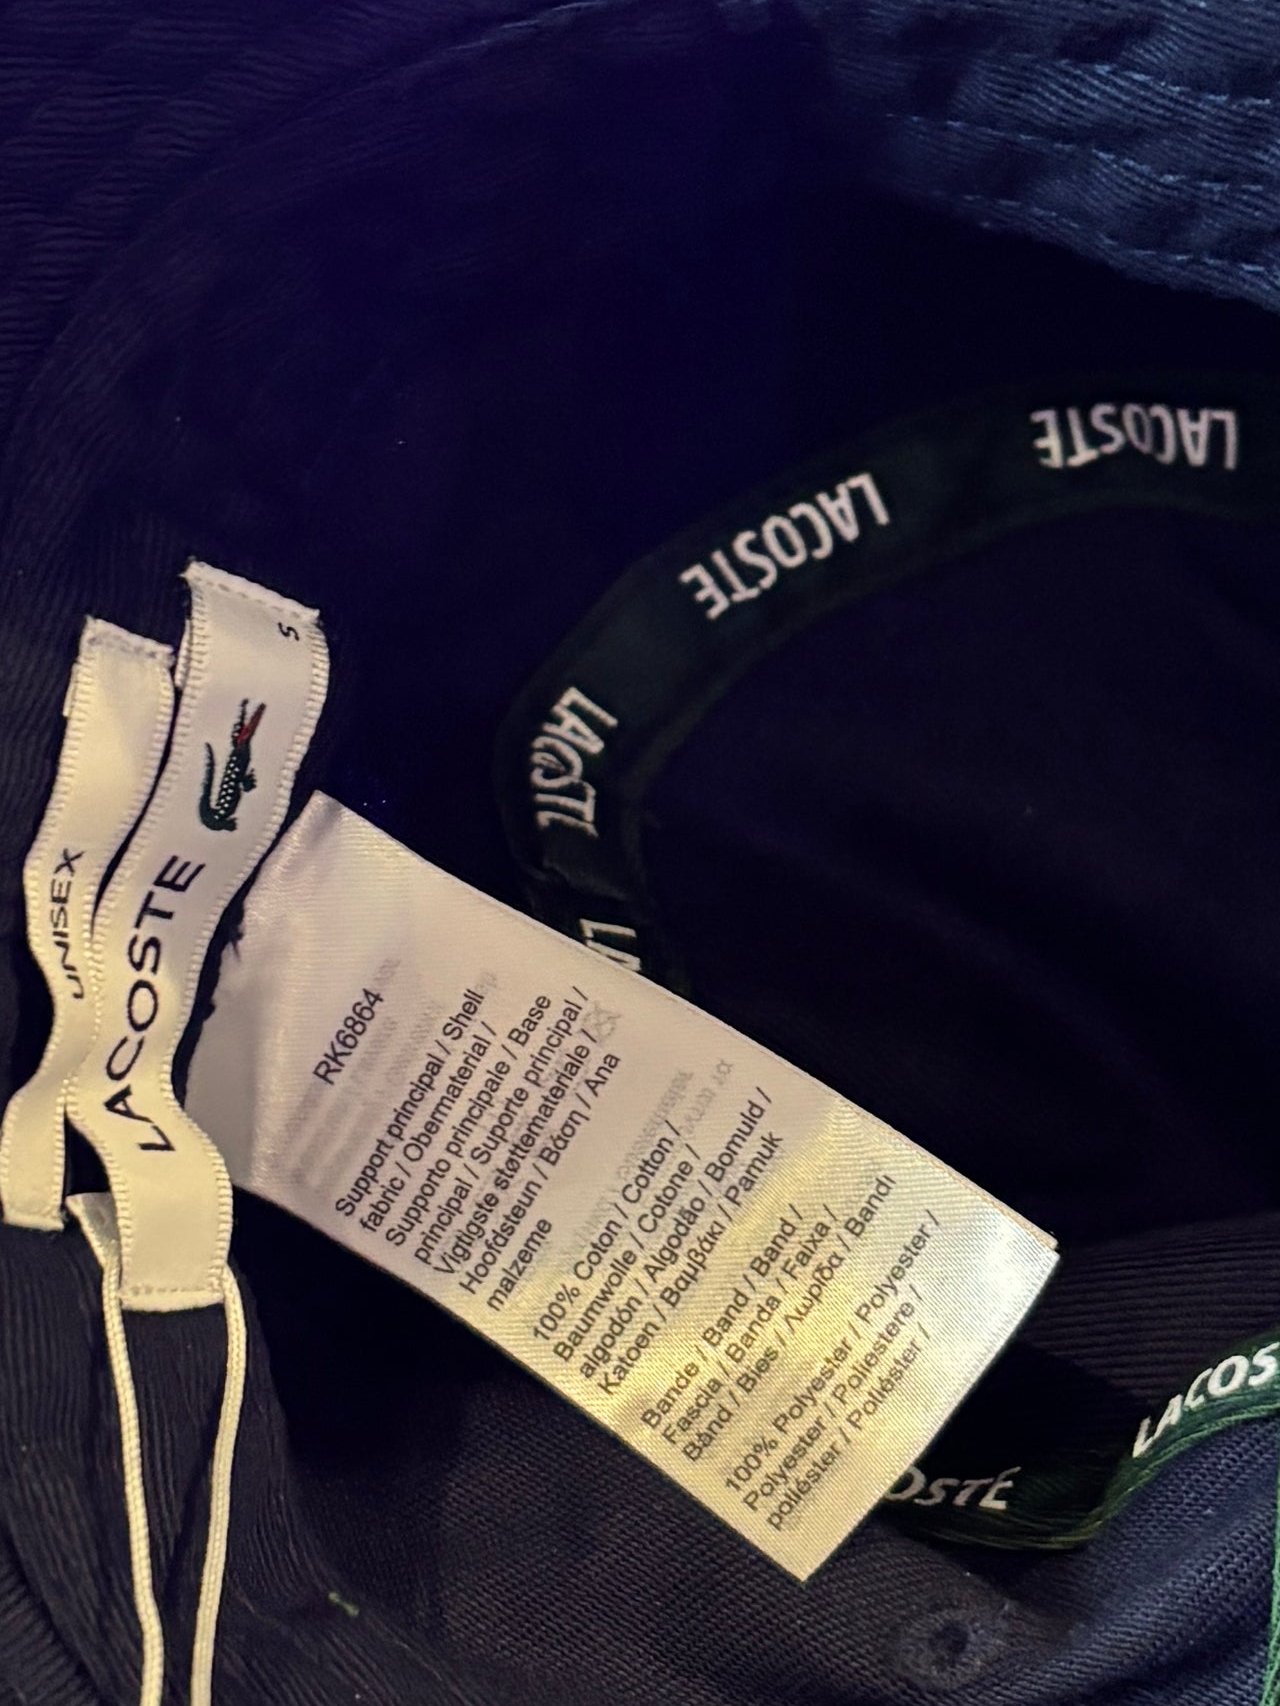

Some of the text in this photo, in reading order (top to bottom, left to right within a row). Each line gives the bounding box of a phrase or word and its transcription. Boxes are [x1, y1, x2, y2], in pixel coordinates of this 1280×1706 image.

[681, 474, 888, 618] LACOSTE
[1032, 405, 1236, 467] LACOSTE
[50, 848, 86, 999] UNISEX
[104, 855, 206, 1152] LACOSTE
[312, 988, 383, 1085] RK6864
[334, 988, 484, 1216] Support principal / Shell
[358, 1019, 497, 1232] fabric / Obermaterial /
[384, 995, 551, 1246] Supporto principale / Base
[413, 984, 589, 1265] principal / Suporte principal /
[432, 1027, 598, 1274] Vigtigste støttemateriale /
[458, 1180, 542, 1294] Hoofdsteun
[530, 1161, 549, 1181] /
[573, 1091, 592, 1110] /
[583, 1053, 620, 1097] Ana
[532, 1283, 581, 1340] 100%
[572, 1219, 622, 1280] Coton
[611, 1201, 629, 1220] /
[621, 1136, 674, 1203] Cotton
[663, 1118, 681, 1137] /
[552, 1141, 701, 1362] Baumwolle / Cotone /
[579, 1085, 772, 1379] algodón / Algodão / Bomuld /
[715, 1202, 733, 1222] /
[723, 1131, 783, 1207] Pamuk
[486, 1218, 552, 1311] malzeme
[596, 1321, 661, 1395] Katoen
[639, 1202, 804, 1429] Bande / Band / Band /
[651, 1302, 667, 1323] /
[660, 1201, 839, 1445] Fascia / Banda / Faixa /
[725, 1207, 940, 1491] 100% Polyester / Polyester /
[726, 1388, 741, 1408] /
[735, 1349, 778, 1394] Bies
[772, 1327, 788, 1348] /
[835, 1232, 852, 1253] /
[742, 1282, 923, 1511] Polyester / Poliestere /
[836, 1426, 852, 1446] /
[915, 1320, 931, 1341] /
